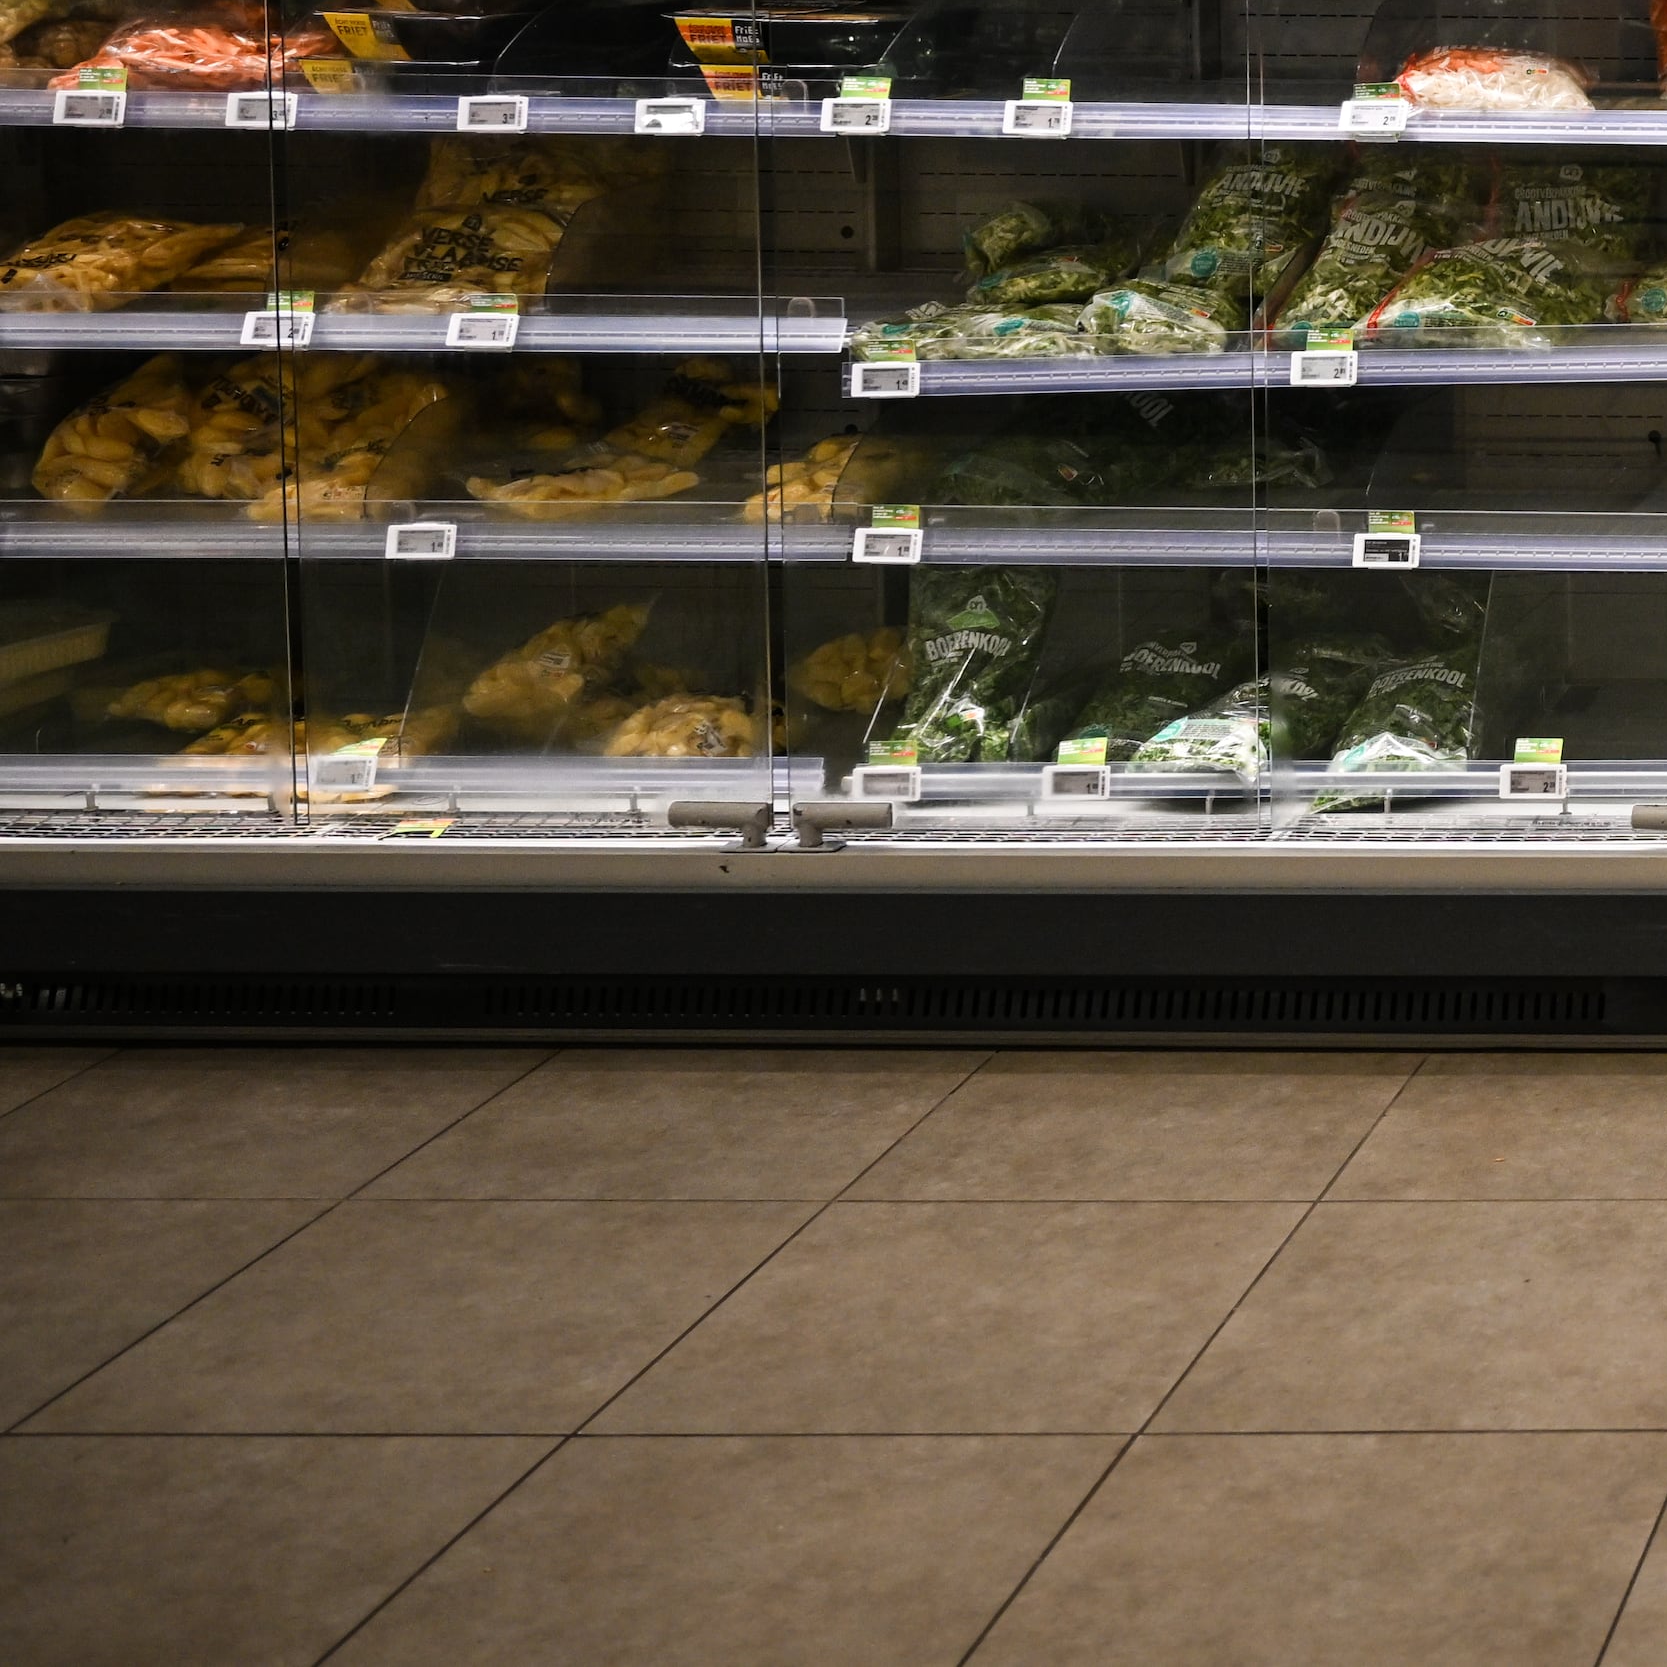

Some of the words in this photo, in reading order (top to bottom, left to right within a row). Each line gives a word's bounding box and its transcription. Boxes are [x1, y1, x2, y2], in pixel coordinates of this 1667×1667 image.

[337, 26, 367, 36] FRIET
[690, 35, 726, 43] FRIET
[715, 83, 751, 91] FRIET
[422, 227, 494, 250] VERSE
